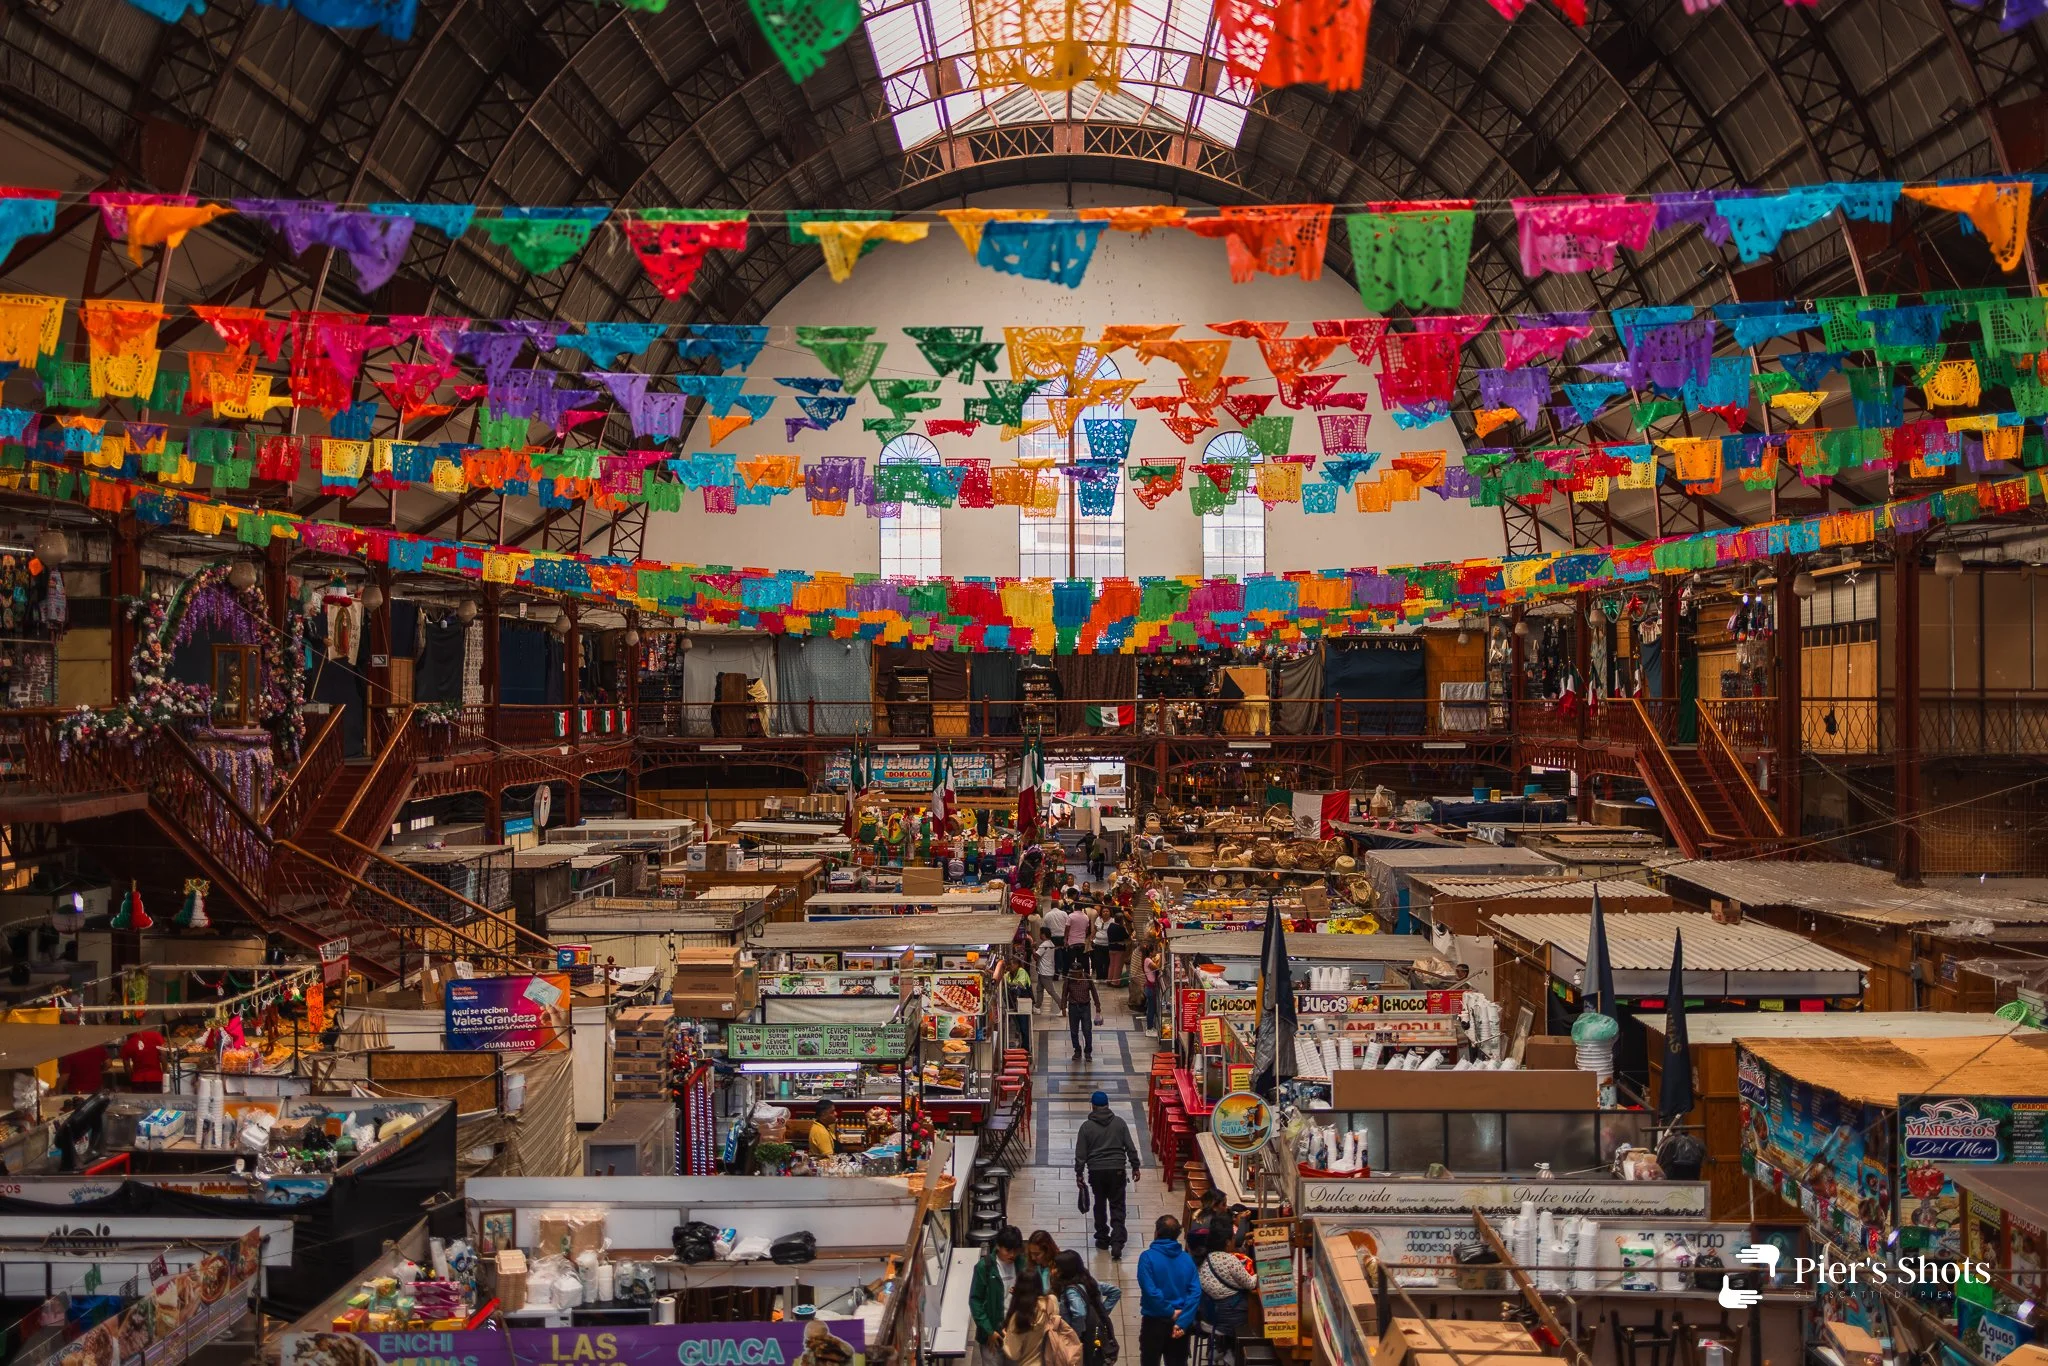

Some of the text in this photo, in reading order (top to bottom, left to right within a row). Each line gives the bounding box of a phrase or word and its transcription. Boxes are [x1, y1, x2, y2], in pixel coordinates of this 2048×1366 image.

[942, 756, 985, 770] CREALES
[480, 1006, 509, 1014] reciben
[453, 1013, 537, 1026] Vales Grandeza
[484, 1040, 536, 1049] GUANAJUATO
[1906, 1124, 1996, 1137] MARISCOS
[1911, 1140, 1992, 1157] Del Mar
[1310, 1185, 1355, 1203] Dulce
[1358, 1186, 1391, 1203] vida
[1513, 1187, 1559, 1204] Dulce
[1562, 1187, 1596, 1203] vida
[1267, 1323, 1297, 1331] CREPAS
[1980, 1319, 2014, 1346] Aguas
[379, 1333, 454, 1353] ENCHI
[552, 1332, 618, 1361] LAS
[678, 1337, 785, 1366] GUACA
[1985, 1344, 2005, 1362] Fre
